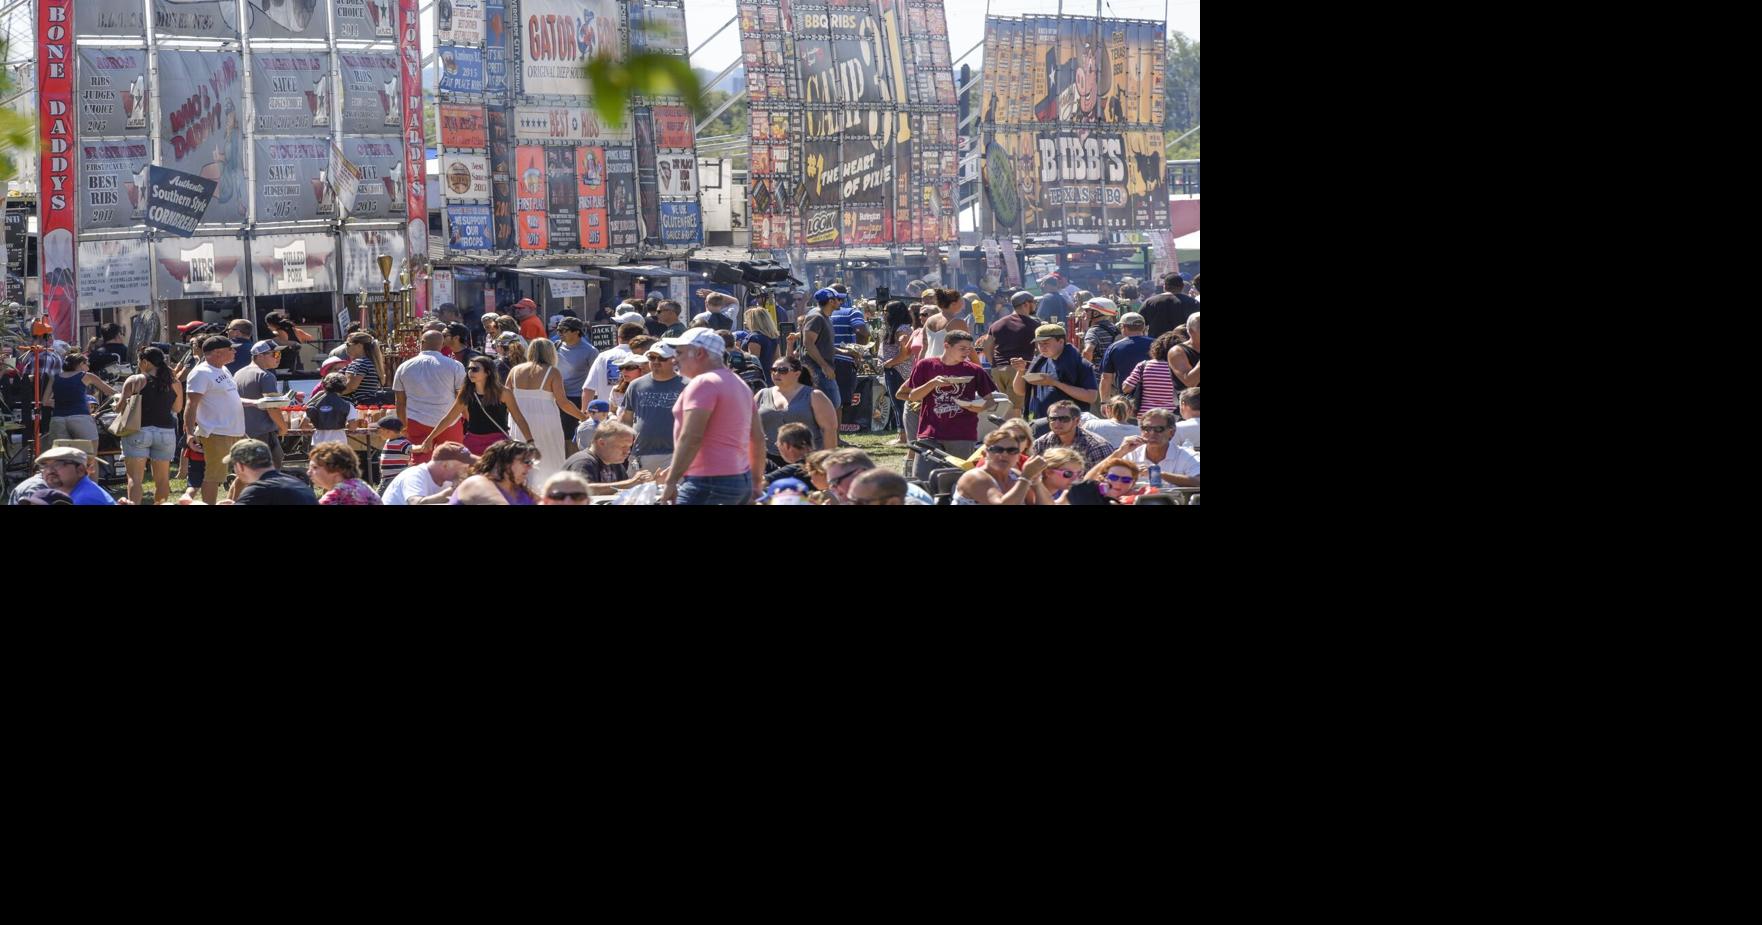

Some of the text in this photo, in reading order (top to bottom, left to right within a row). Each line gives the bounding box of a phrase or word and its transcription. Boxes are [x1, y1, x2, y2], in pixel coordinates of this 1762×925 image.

[337, 7, 364, 18] CHOICE
[804, 13, 857, 30] BBQ RIBS
[528, 14, 577, 62] GATOR
[527, 65, 556, 79] ORIGINAL
[91, 76, 111, 86] RIBS
[83, 90, 115, 100] JUDGES
[46, 6, 69, 211] BONE DADDYS
[84, 104, 114, 115] CHOICE
[549, 109, 600, 138] BEST RIBS
[1040, 135, 1125, 183] BIBB'S
[805, 153, 824, 197] #1
[821, 152, 876, 188] THE HEART
[89, 175, 118, 190] BEST
[843, 177, 861, 198] OF
[91, 191, 119, 205] RIBS
[152, 184, 208, 213] Southern Style
[1048, 185, 1090, 206] TEXAS
[148, 205, 200, 232] CORNBREAD
[463, 215, 488, 226] SUPPORT
[805, 210, 837, 237] LOOK
[1042, 215, 1084, 228] Austin
[1091, 215, 1127, 227] Texas
[465, 226, 479, 236] OUR
[461, 236, 484, 247] TROOPS
[282, 250, 306, 267] PULLED
[191, 258, 215, 282] RIBS
[593, 326, 610, 335] JACK
[593, 339, 611, 347] BONE
